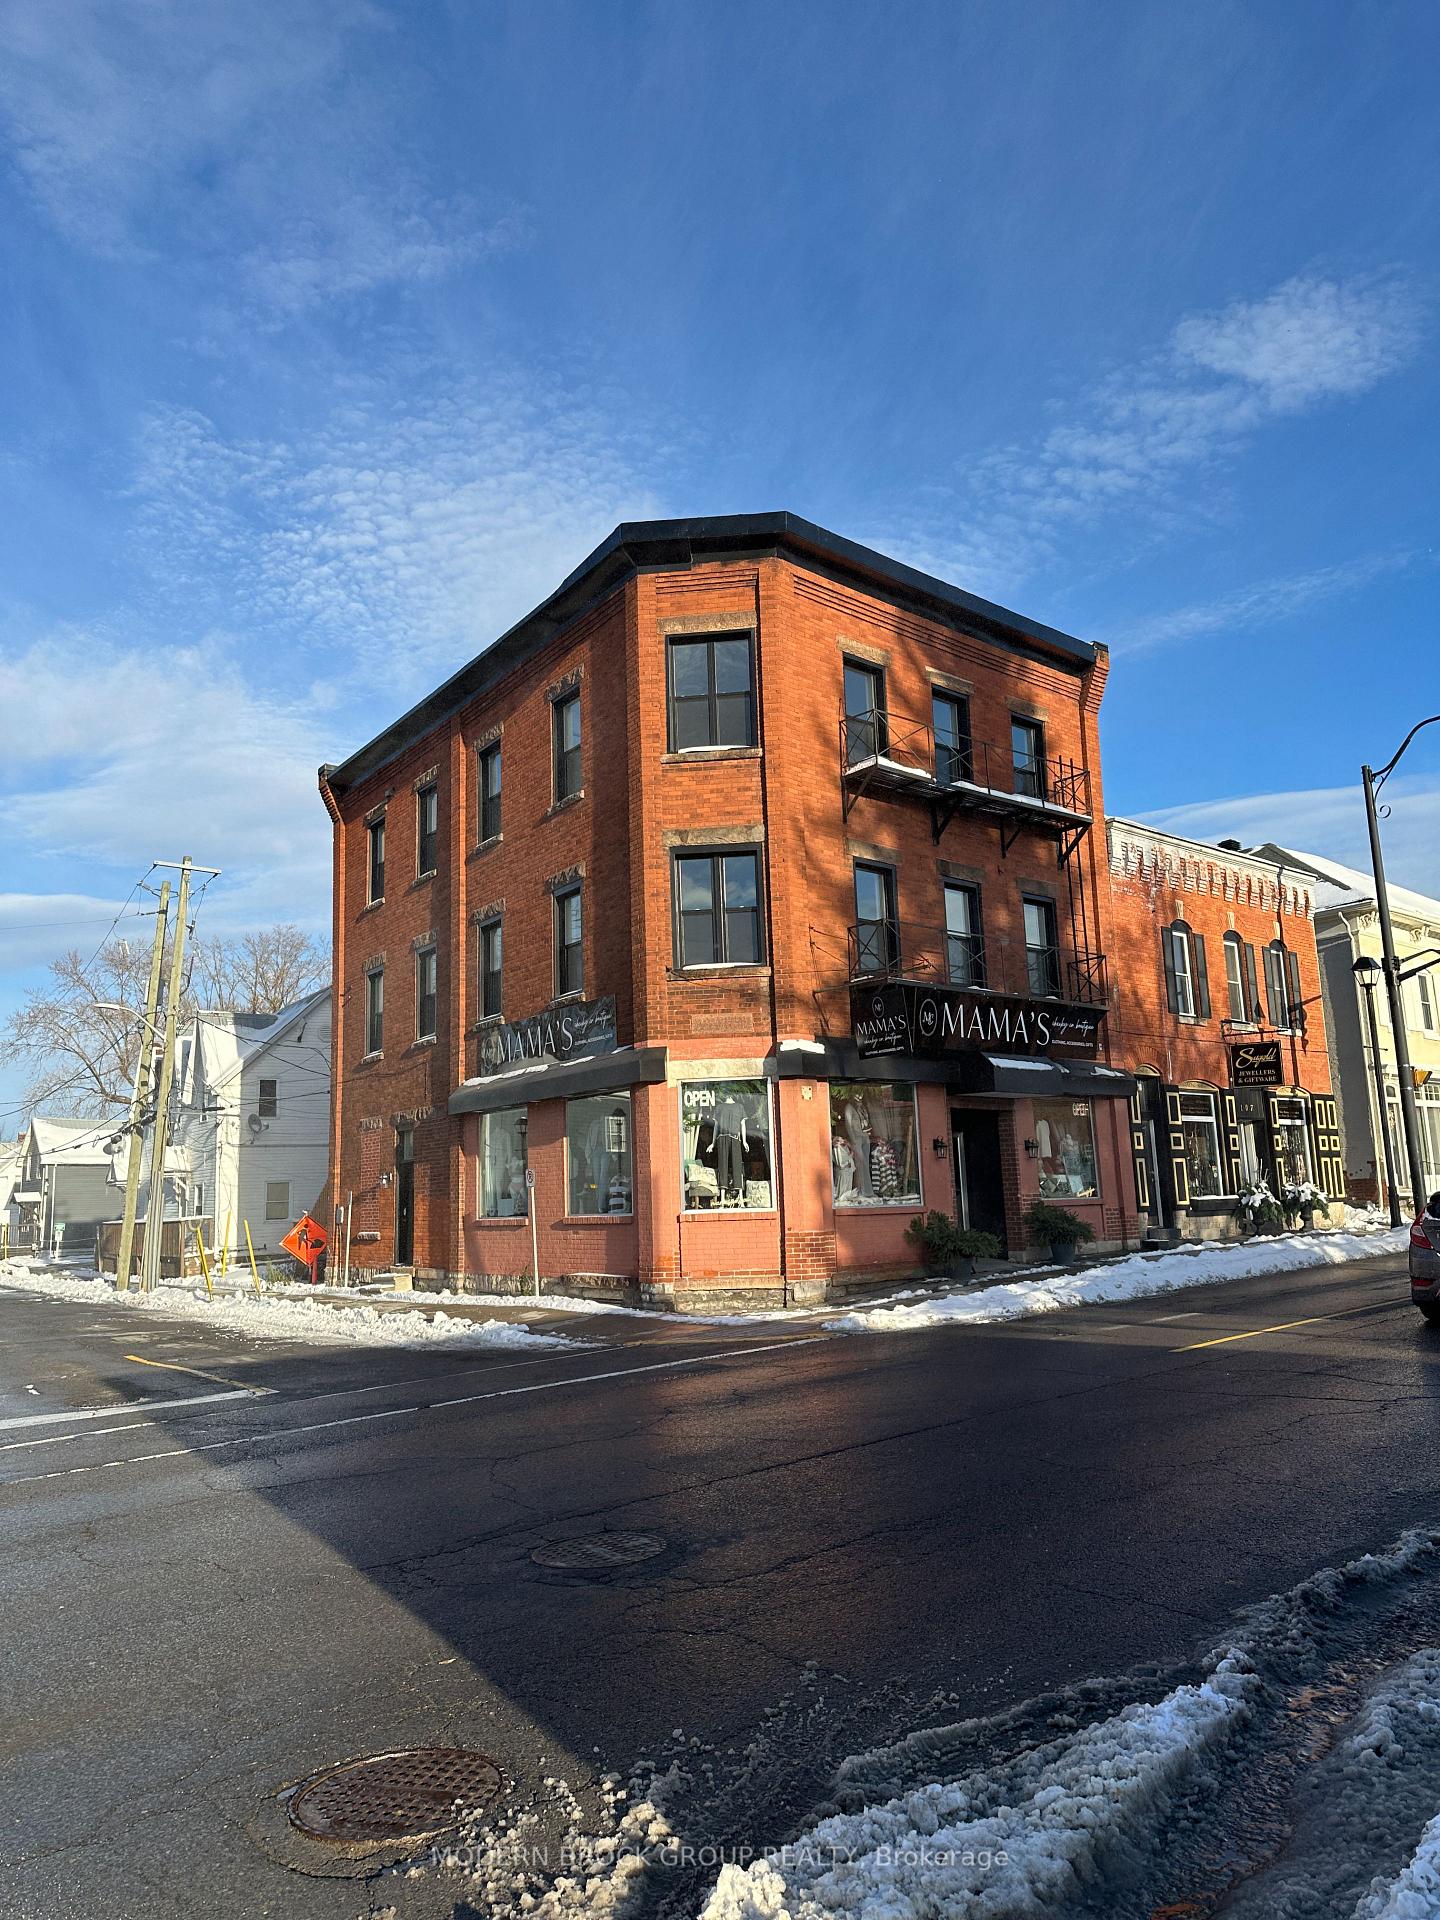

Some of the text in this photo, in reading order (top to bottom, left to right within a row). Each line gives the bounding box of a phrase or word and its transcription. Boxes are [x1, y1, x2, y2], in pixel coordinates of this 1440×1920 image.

[857, 1014, 906, 1037] MAMA'S
[941, 1002, 1050, 1046] MAMA'S
[497, 1017, 573, 1064] MAMA'S
[1238, 1069, 1277, 1077] JEWELLERS
[1244, 1075, 1278, 1083] GIFTWARE
[683, 1090, 716, 1107] OPEN
